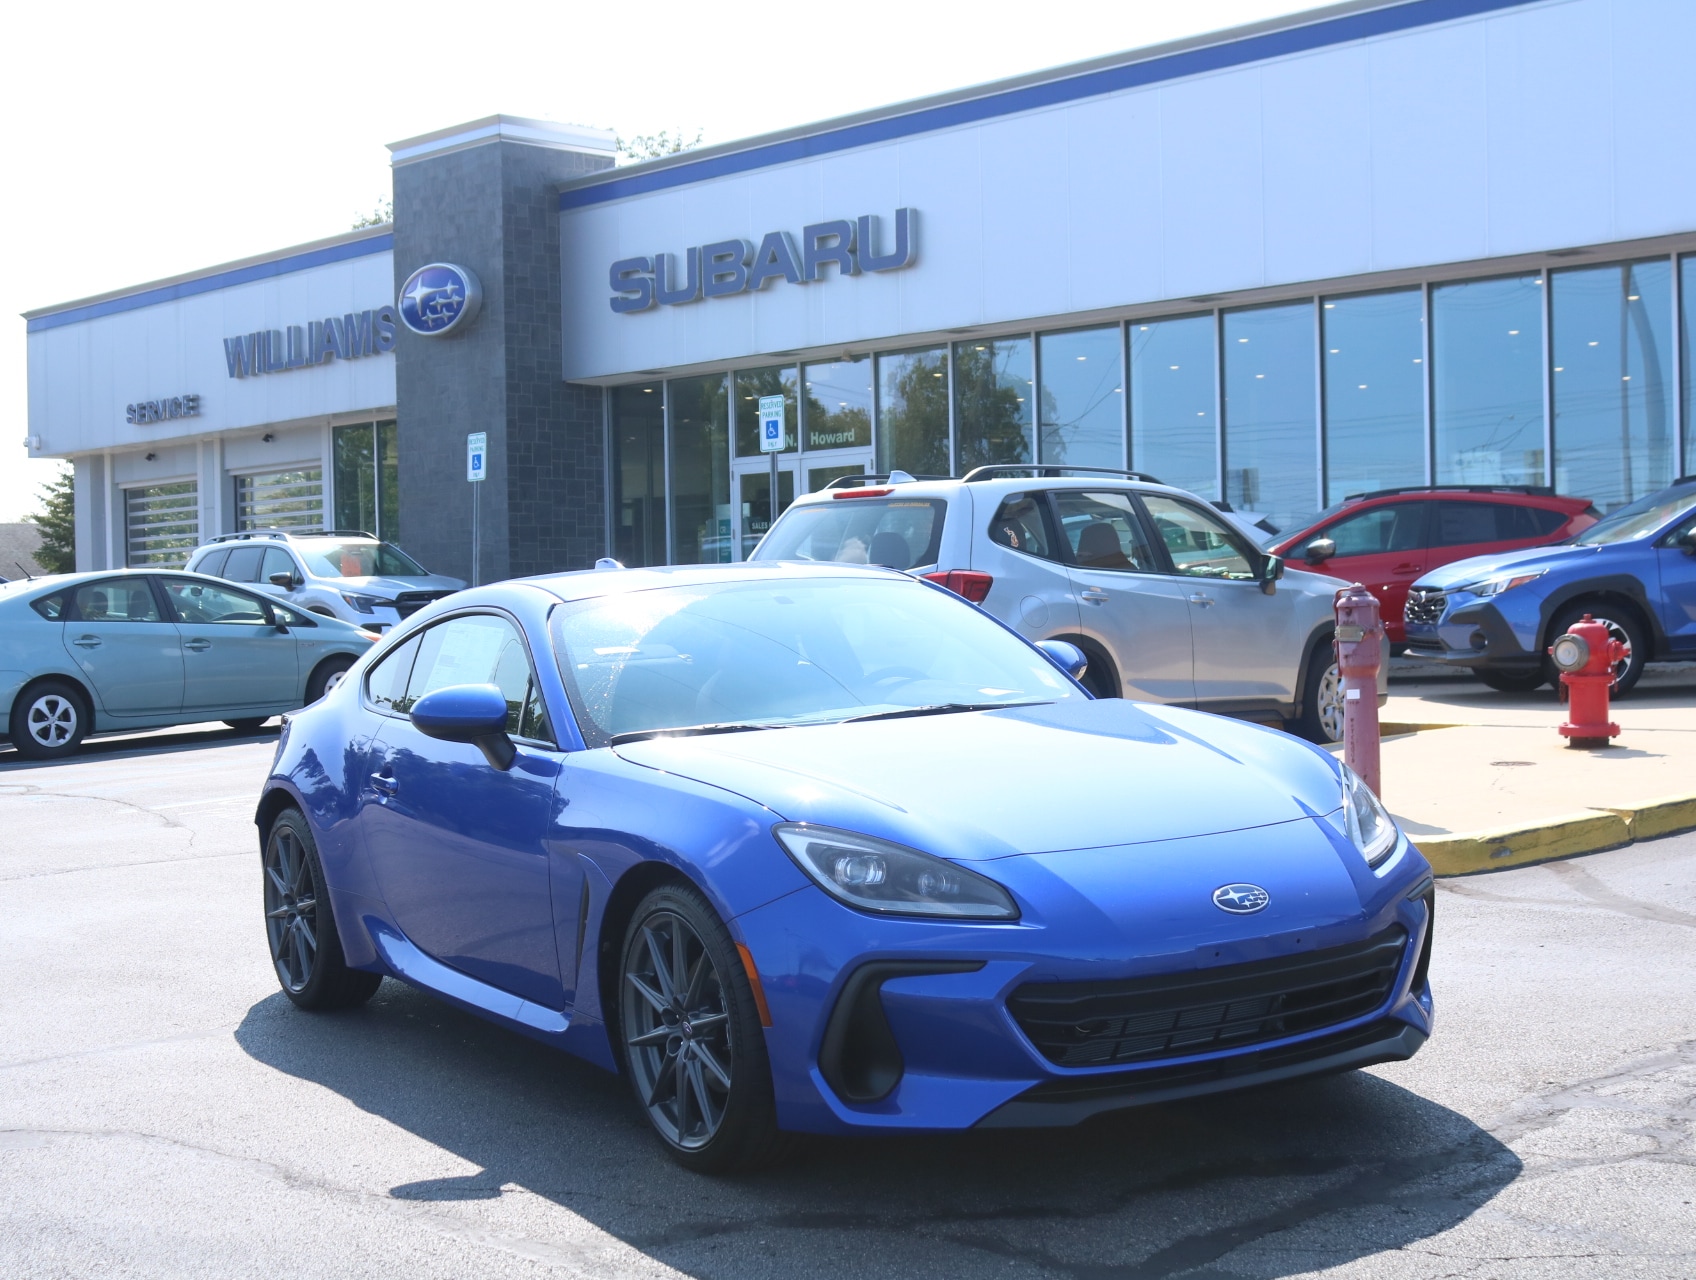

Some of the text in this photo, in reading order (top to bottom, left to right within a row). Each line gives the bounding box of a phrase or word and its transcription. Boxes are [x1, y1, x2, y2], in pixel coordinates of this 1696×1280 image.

[610, 208, 915, 313] SUBARU
[223, 305, 396, 378] WILLIAMS
[126, 395, 201, 424] SERVICE
[760, 400, 782, 410] RESERVED
[762, 409, 782, 418] PARKING
[810, 428, 855, 445] Howard
[751, 521, 768, 530] SALES
